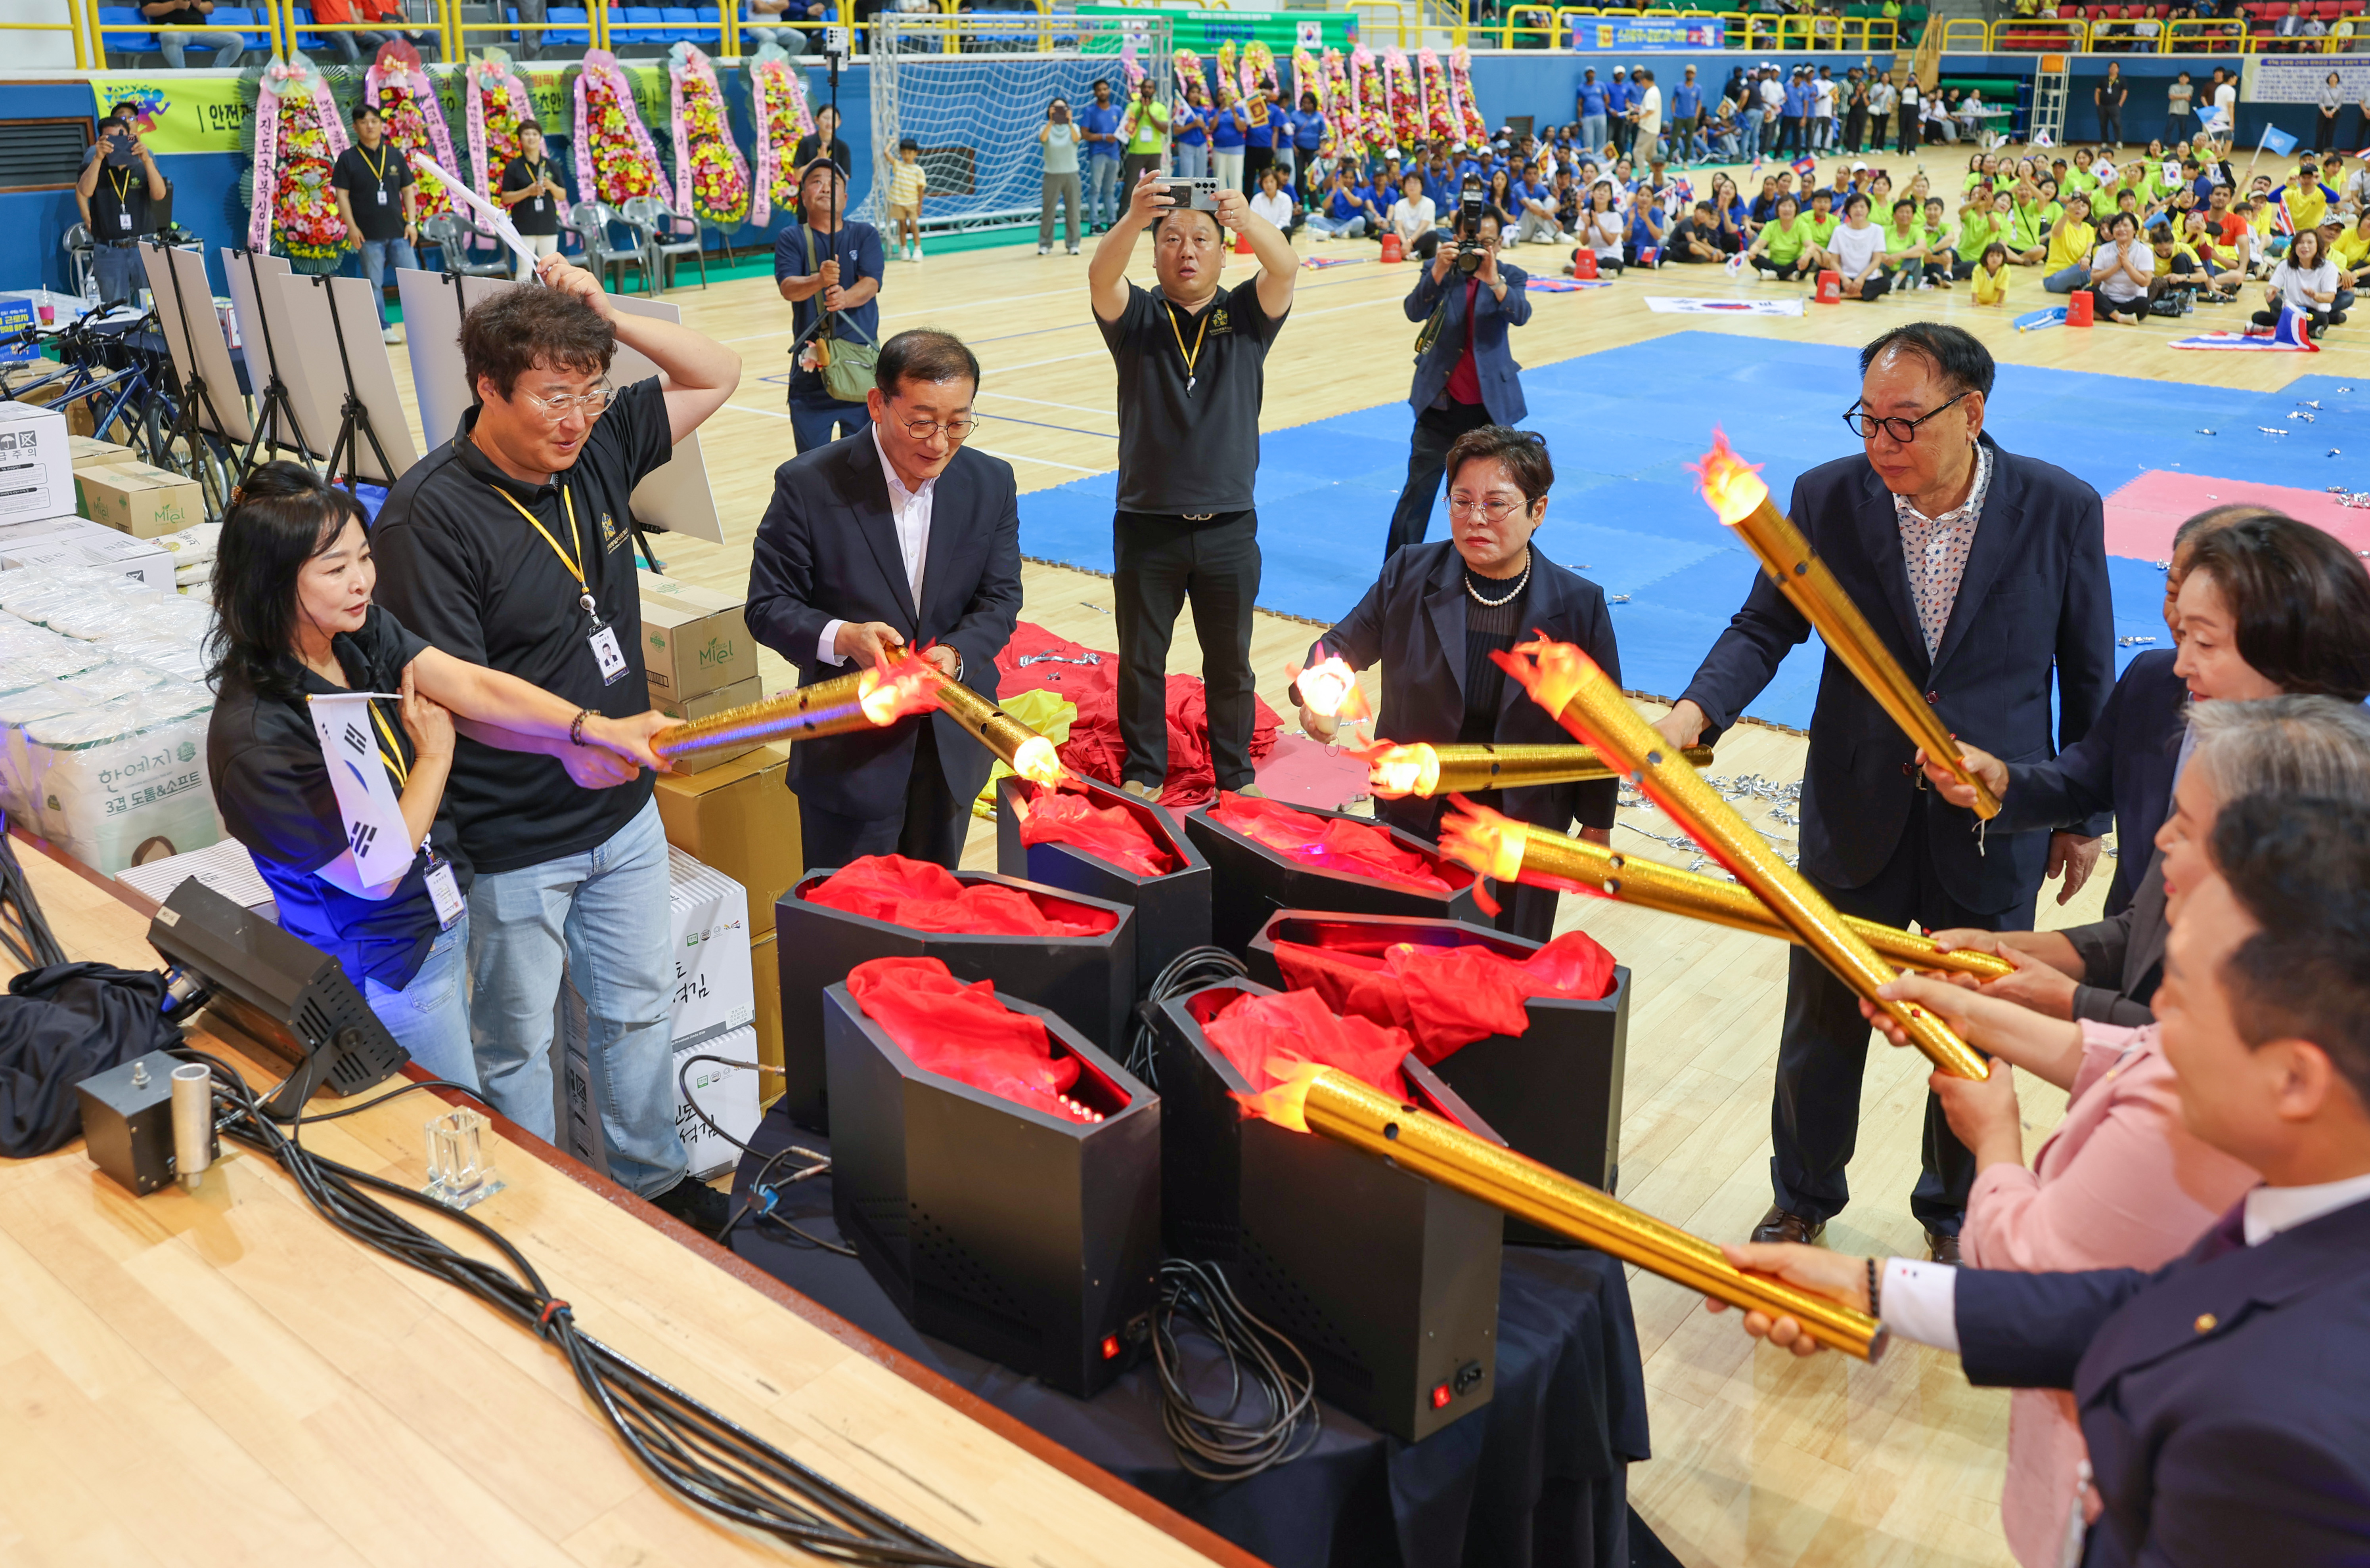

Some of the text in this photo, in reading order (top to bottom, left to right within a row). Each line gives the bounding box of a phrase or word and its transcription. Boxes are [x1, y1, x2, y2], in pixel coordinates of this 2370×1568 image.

[5, 314, 29, 325] 근로자
[155, 504, 185, 524] Miel
[699, 637, 733, 665] Miel
[98, 749, 171, 793] 한예지
[105, 771, 202, 813] 3겹 도톰&소프트
[673, 973, 710, 1003] 석김
